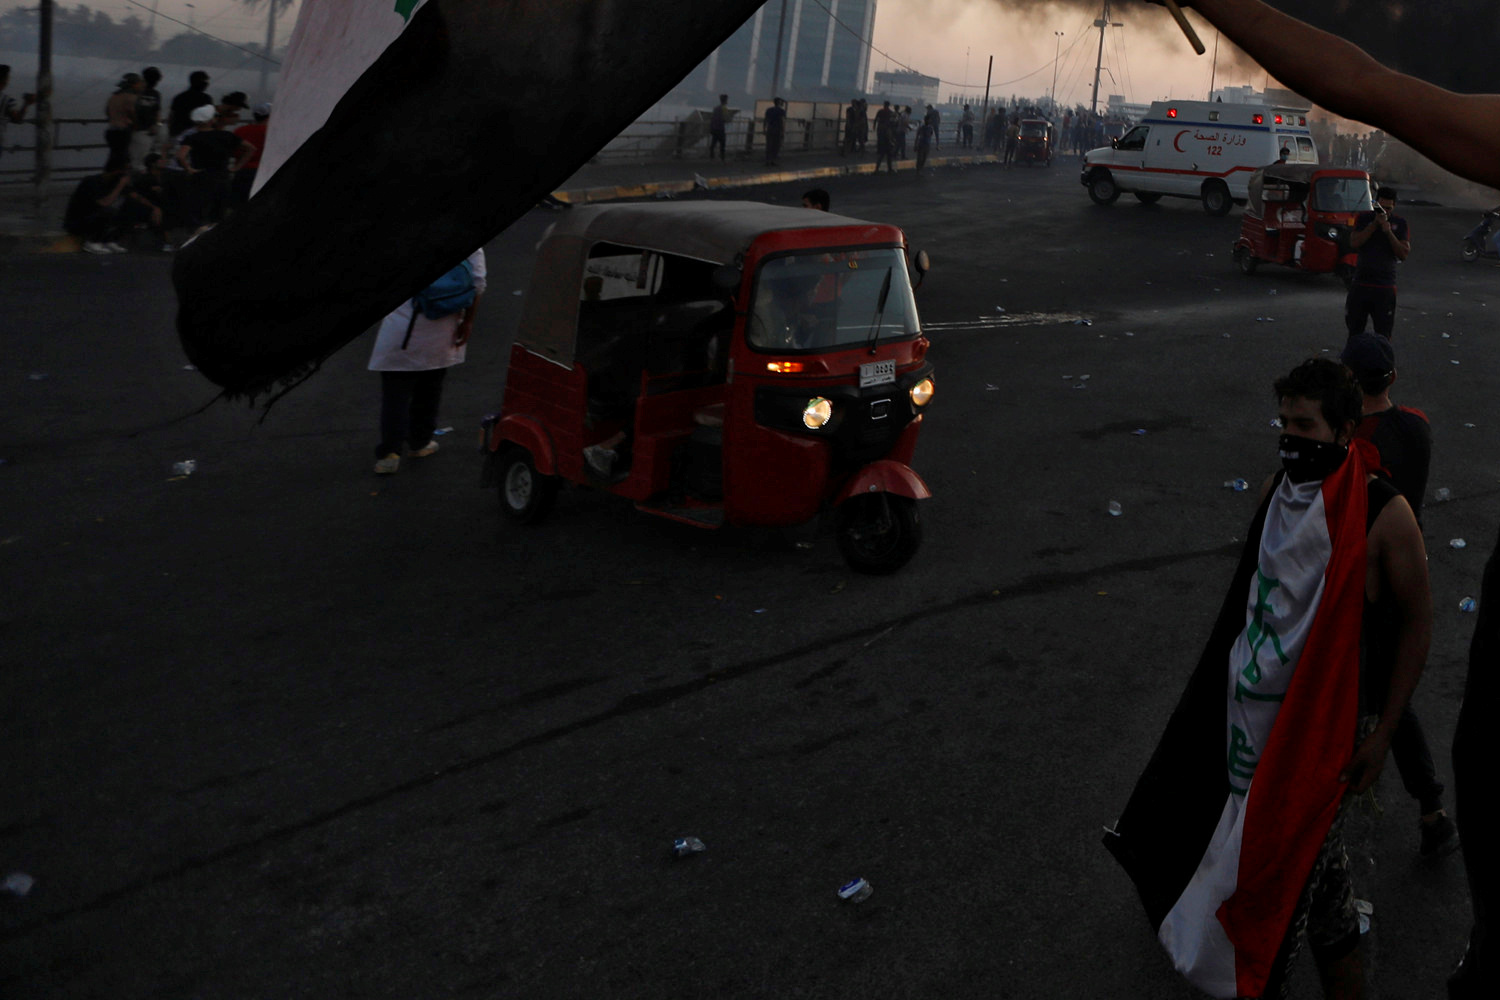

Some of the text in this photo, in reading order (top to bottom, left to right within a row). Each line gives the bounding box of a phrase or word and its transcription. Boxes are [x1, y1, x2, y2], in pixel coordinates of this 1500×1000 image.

[1194, 129, 1246, 146] وزارة الصحة
[1207, 145, 1222, 156] 122
